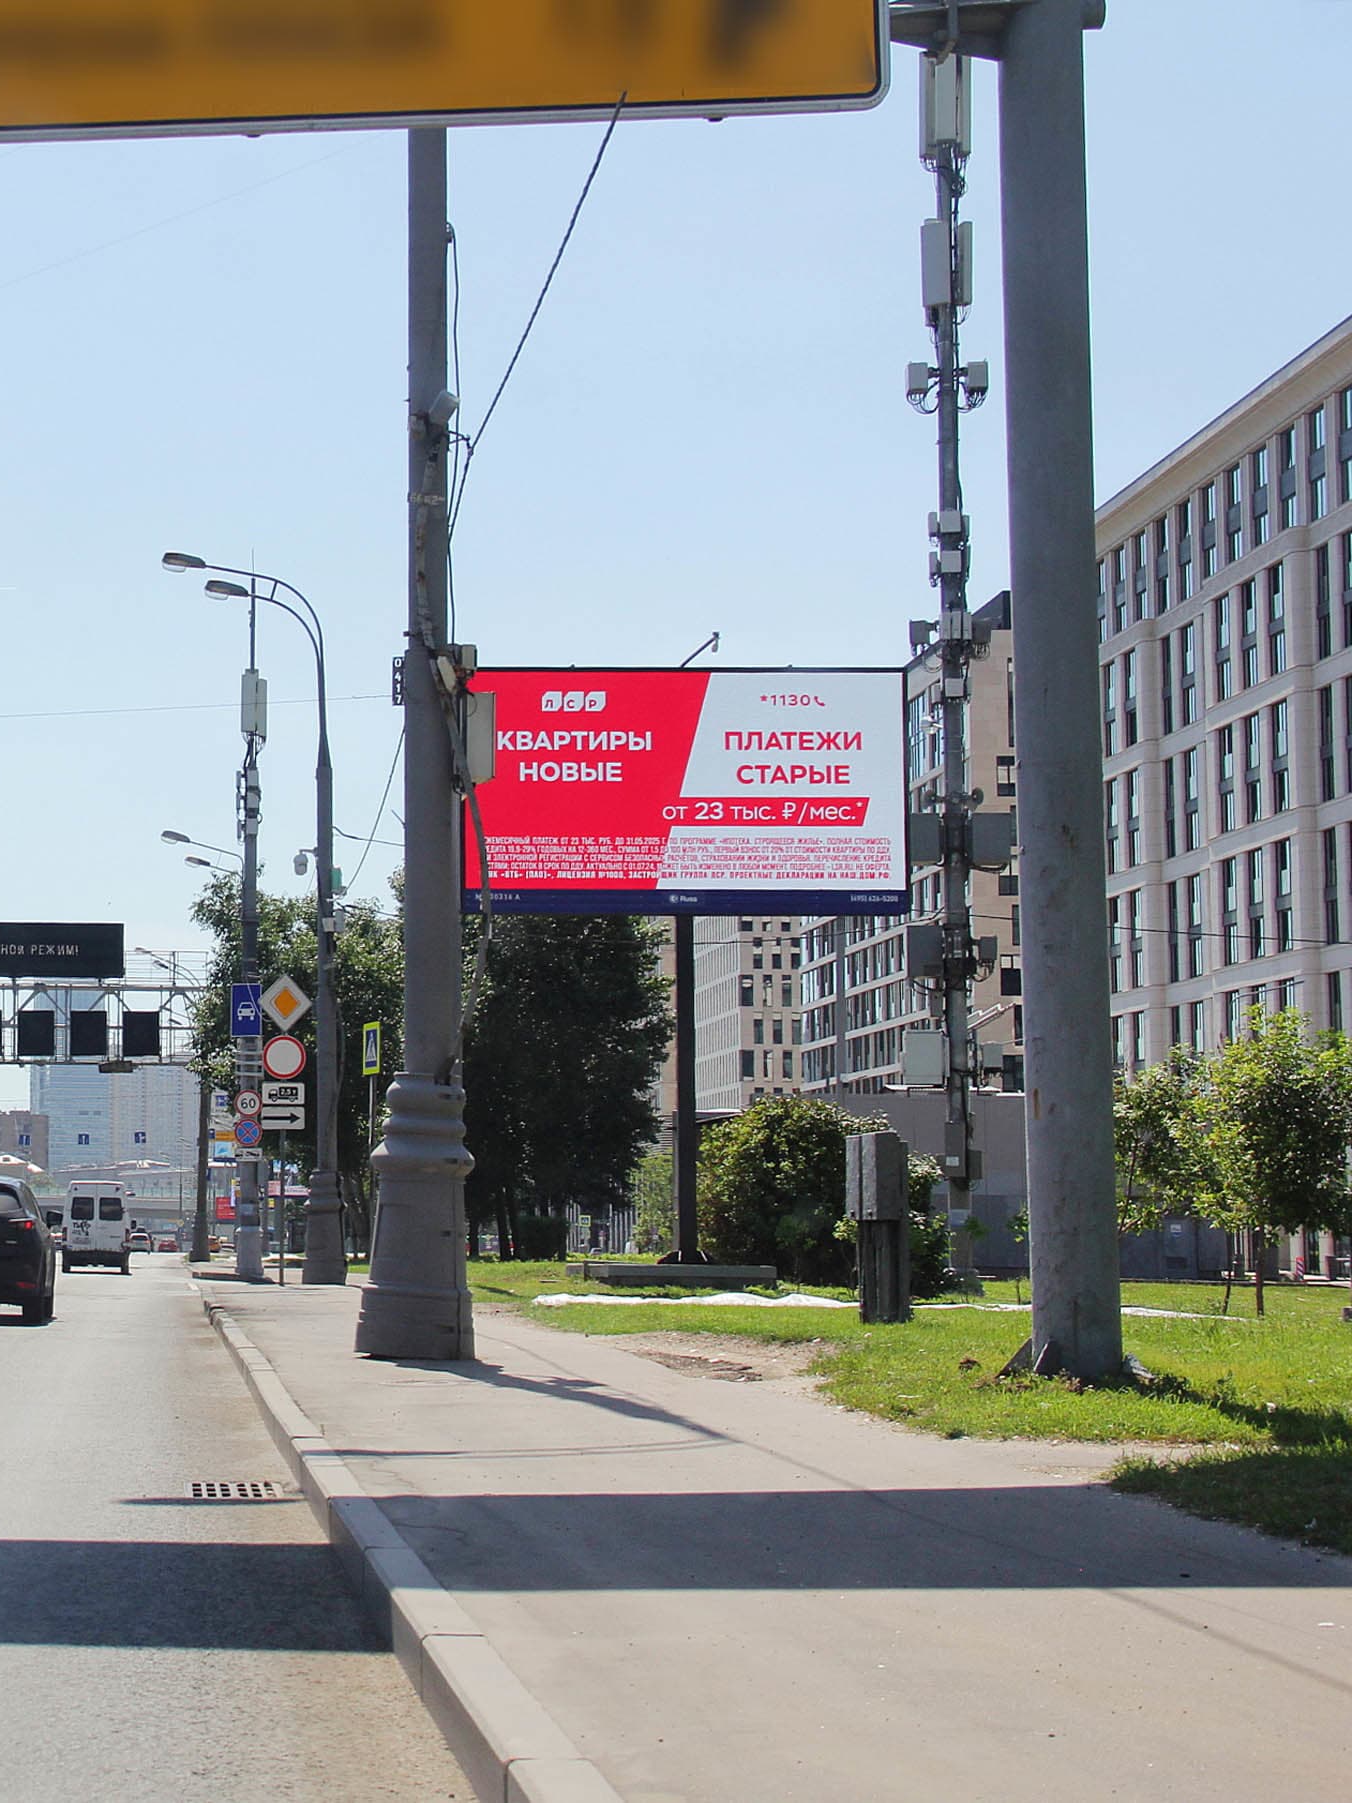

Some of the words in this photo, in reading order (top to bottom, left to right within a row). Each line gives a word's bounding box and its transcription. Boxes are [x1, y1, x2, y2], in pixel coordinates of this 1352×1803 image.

[496, 731, 652, 751] КВАРТИРЫ
[724, 731, 862, 751] ПЛАТЕЖИ
[519, 762, 623, 782] НОВЫЕ
[736, 765, 851, 784] СТАРЫЕ
[694, 802, 724, 820] 23
[30, 944, 79, 956] РЕЖИМ!
[240, 1098, 256, 1109] 60
